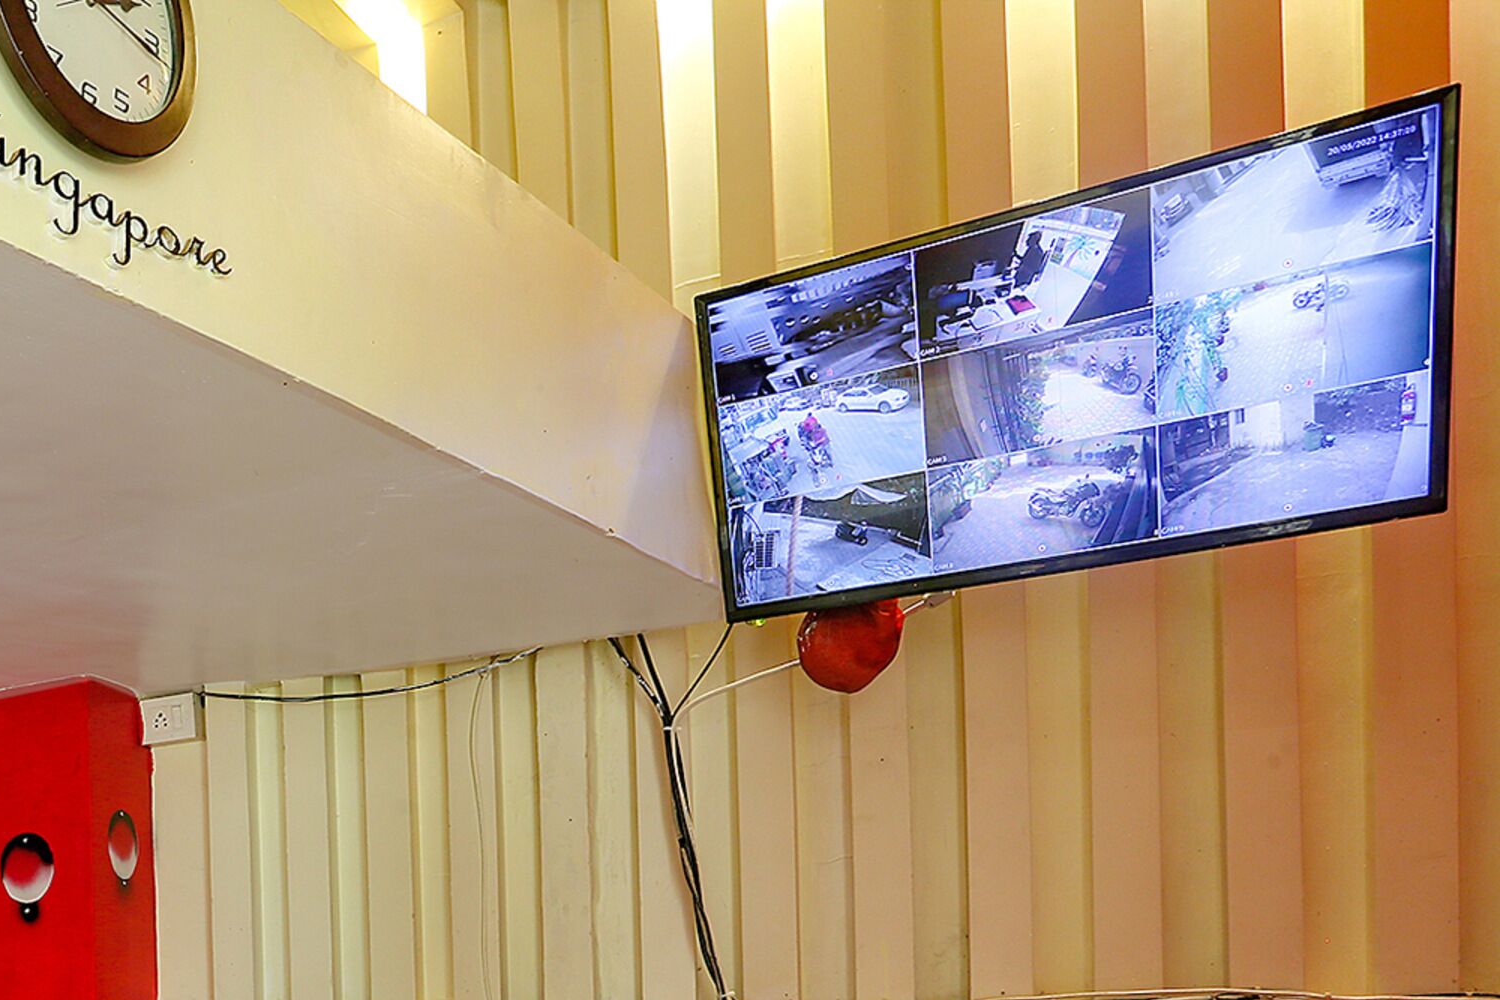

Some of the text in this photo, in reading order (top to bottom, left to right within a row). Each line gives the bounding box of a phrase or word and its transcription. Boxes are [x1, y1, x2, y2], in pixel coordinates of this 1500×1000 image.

[145, 28, 160, 55] 3
[81, 81, 98, 106] 6
[137, 74, 152, 96] 4
[113, 87, 130, 114] 5
